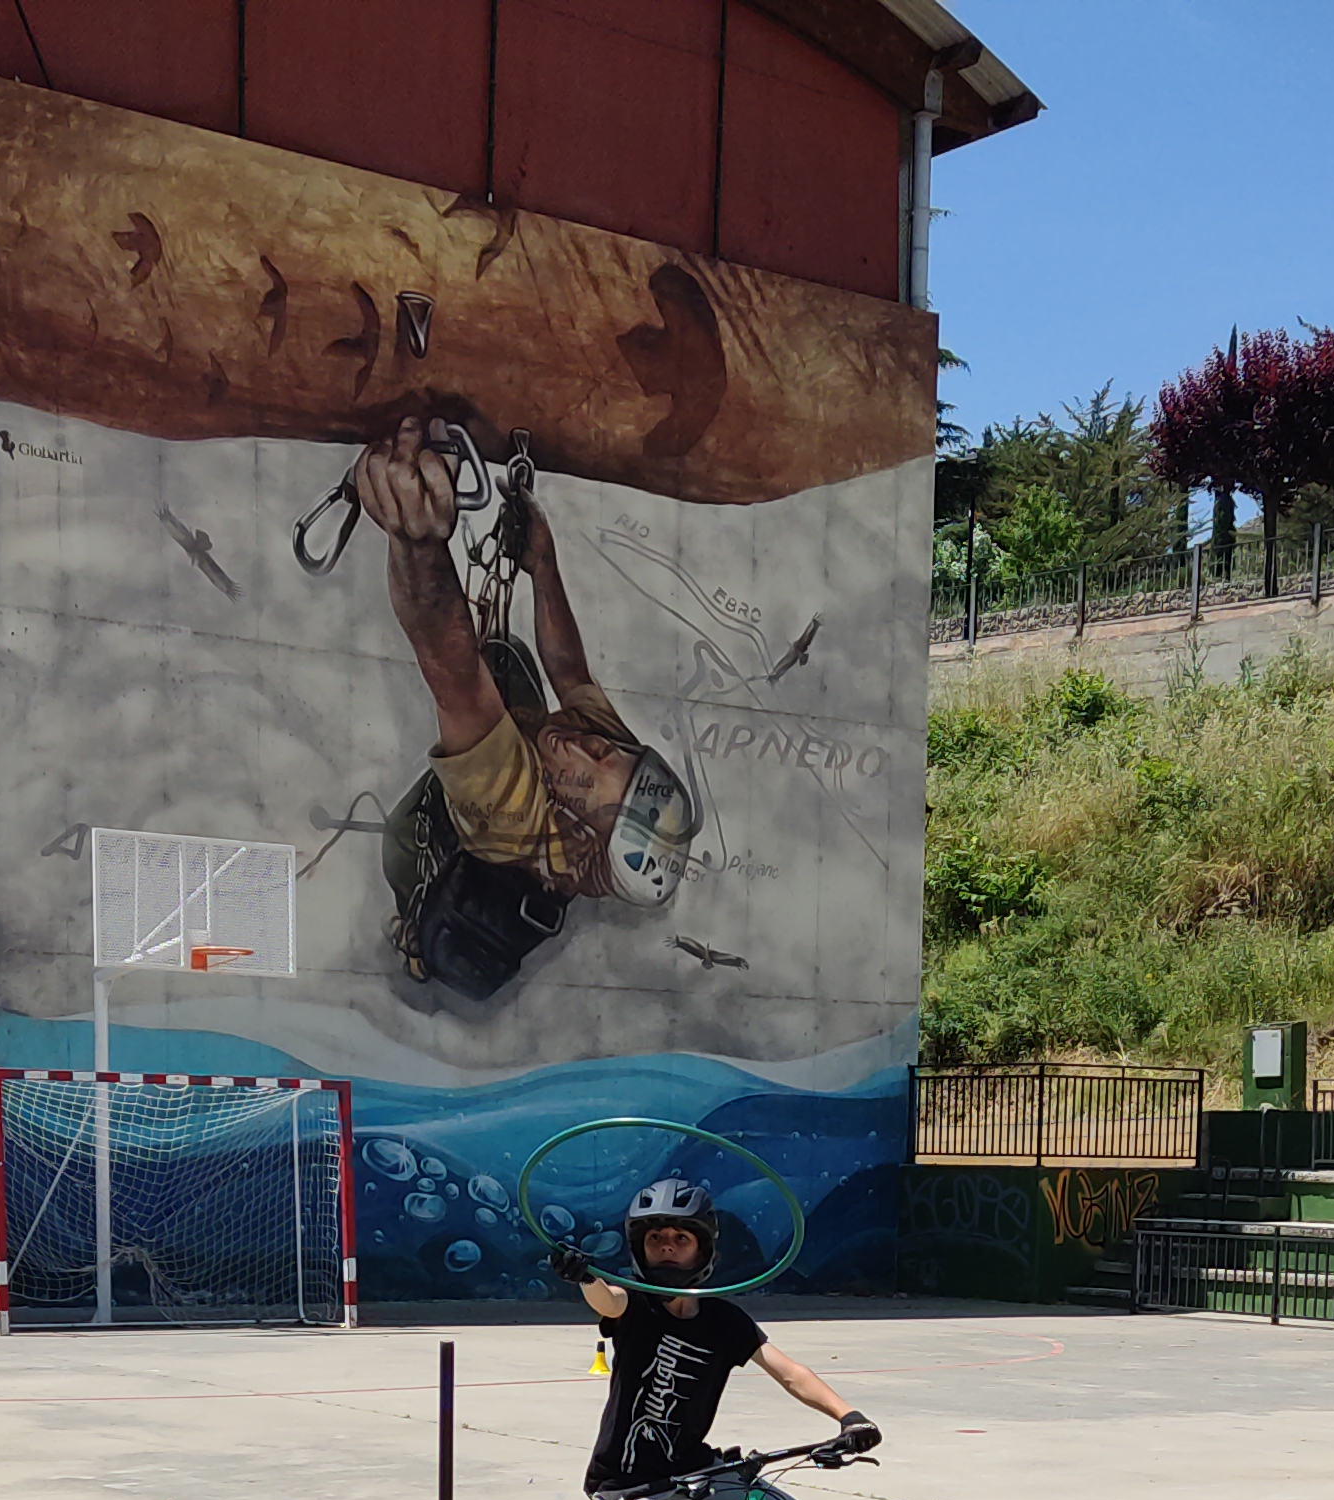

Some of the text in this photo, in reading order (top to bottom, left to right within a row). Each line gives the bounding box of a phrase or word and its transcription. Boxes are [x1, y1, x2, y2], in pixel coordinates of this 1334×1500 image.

[712, 586, 762, 624] EBRO
[692, 722, 888, 778] ARNEDO
[634, 772, 675, 799] Herce
